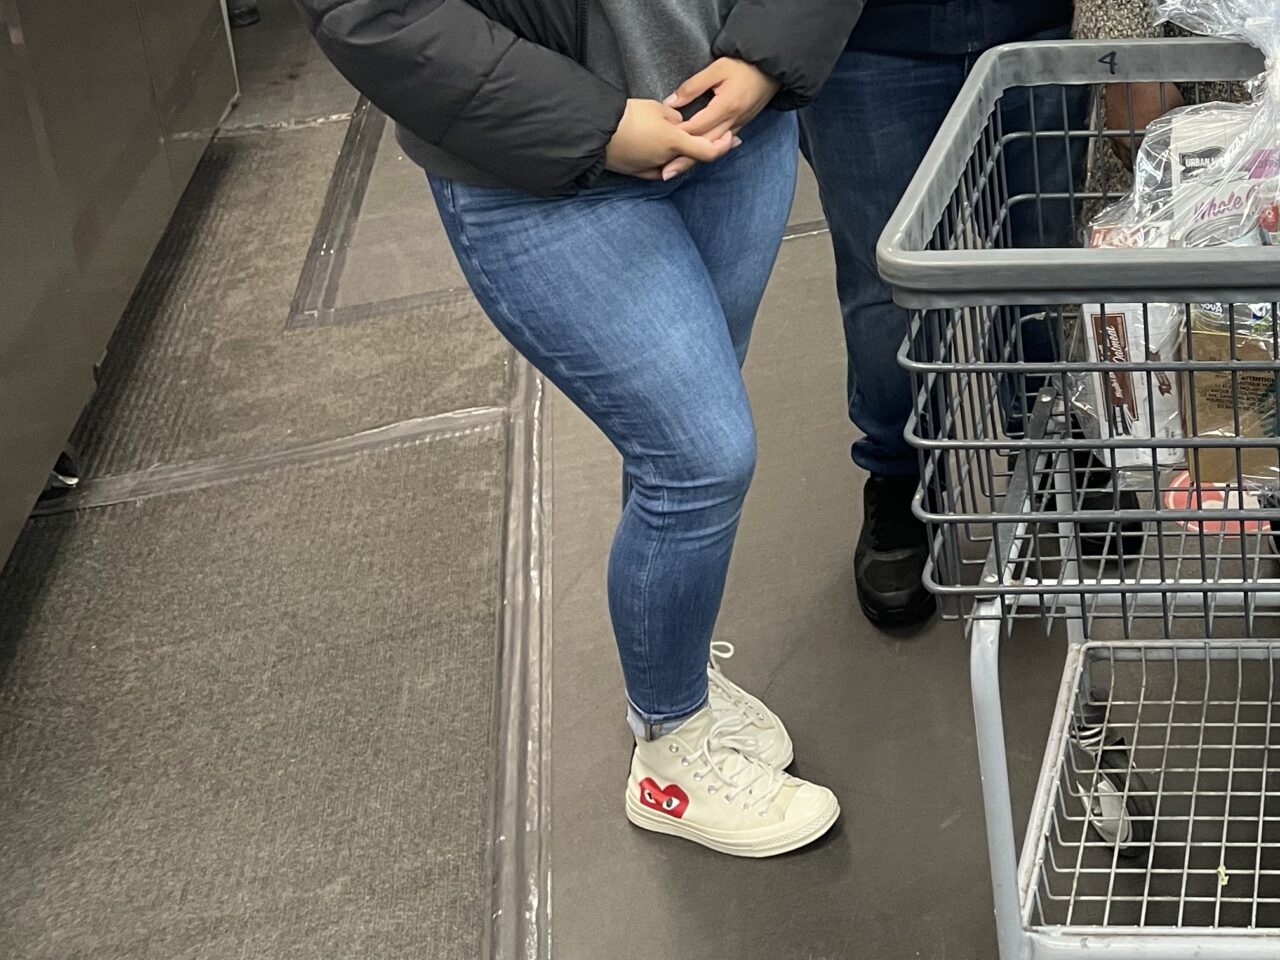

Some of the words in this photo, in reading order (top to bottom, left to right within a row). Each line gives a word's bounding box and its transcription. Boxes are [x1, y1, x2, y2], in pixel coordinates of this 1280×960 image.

[1097, 50, 1118, 75] 4
[1185, 156, 1211, 168] URBAN
[1194, 191, 1244, 223] Whole
